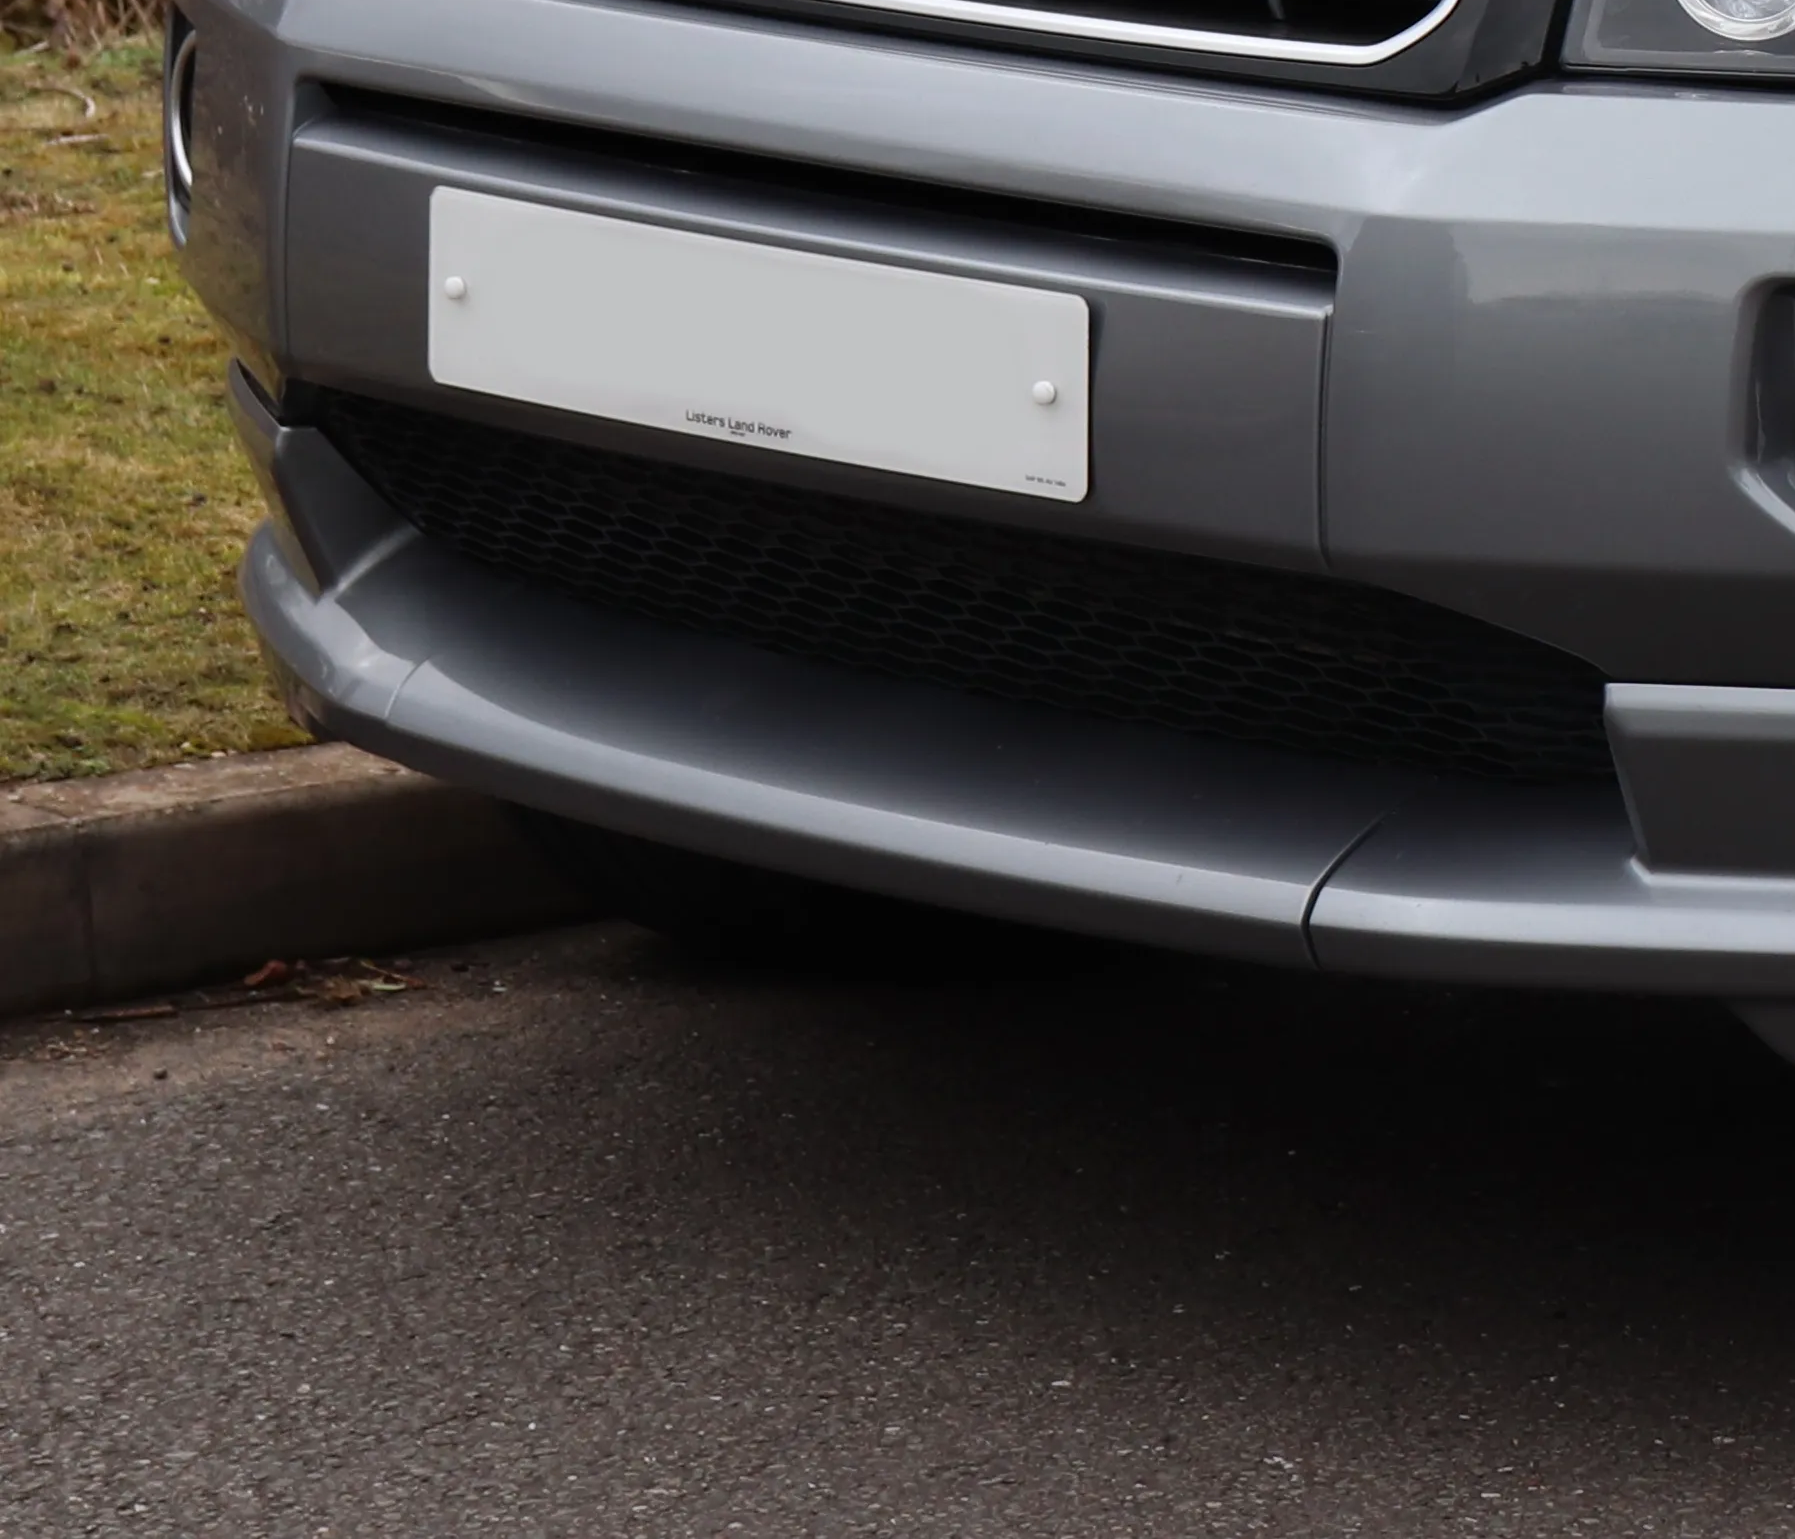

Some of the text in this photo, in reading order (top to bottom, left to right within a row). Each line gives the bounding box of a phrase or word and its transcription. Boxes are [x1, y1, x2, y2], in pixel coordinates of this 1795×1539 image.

[685, 409, 725, 428] Listers
[727, 417, 755, 434] Land
[757, 422, 792, 439] Rover
